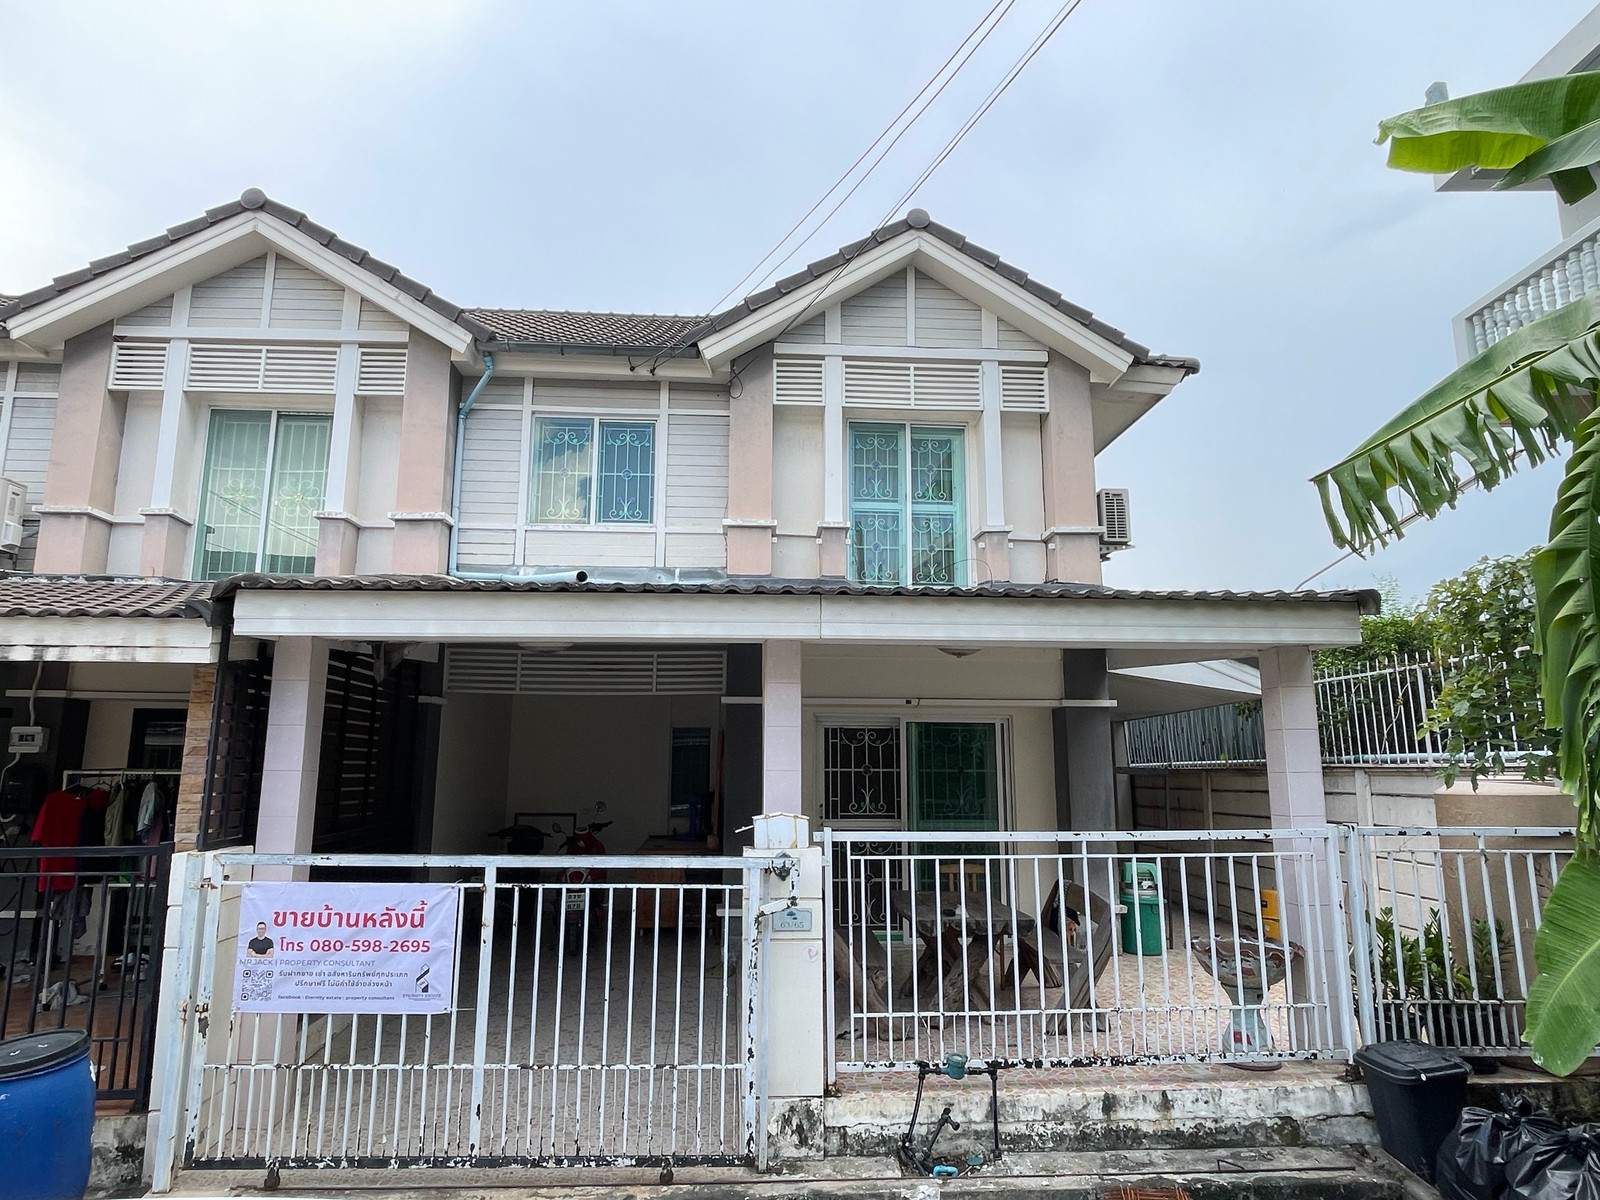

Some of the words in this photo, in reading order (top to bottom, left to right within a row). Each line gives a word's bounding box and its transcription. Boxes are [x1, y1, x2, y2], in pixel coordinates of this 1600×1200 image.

[272, 900, 428, 929] ขายบ้านหลังนี้
[780, 921, 805, 929] 63/65
[279, 937, 304, 952] โทร
[309, 939, 431, 953] 080-598-2695
